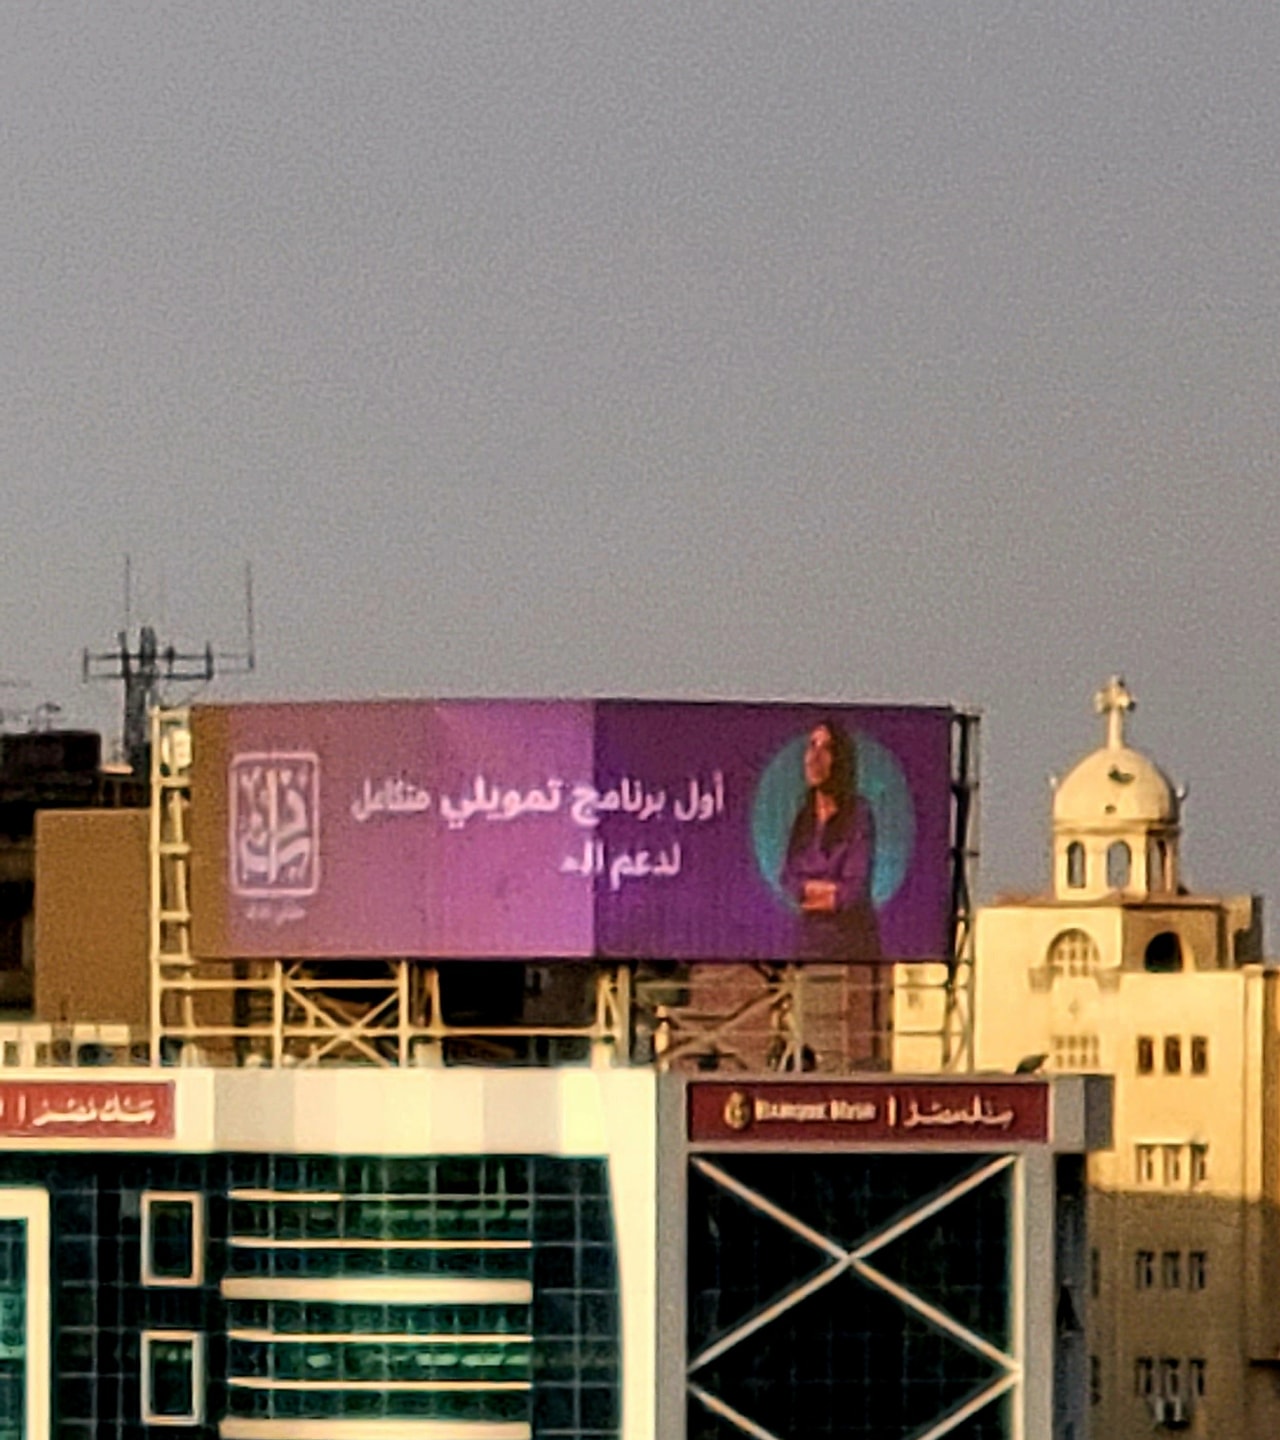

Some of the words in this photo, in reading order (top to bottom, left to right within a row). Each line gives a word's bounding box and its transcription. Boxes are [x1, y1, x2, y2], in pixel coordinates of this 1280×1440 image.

[440, 775, 563, 830] تمويلي
[571, 777, 666, 827] برنامج
[674, 769, 724, 821] أول
[610, 841, 681, 891] لدعم
